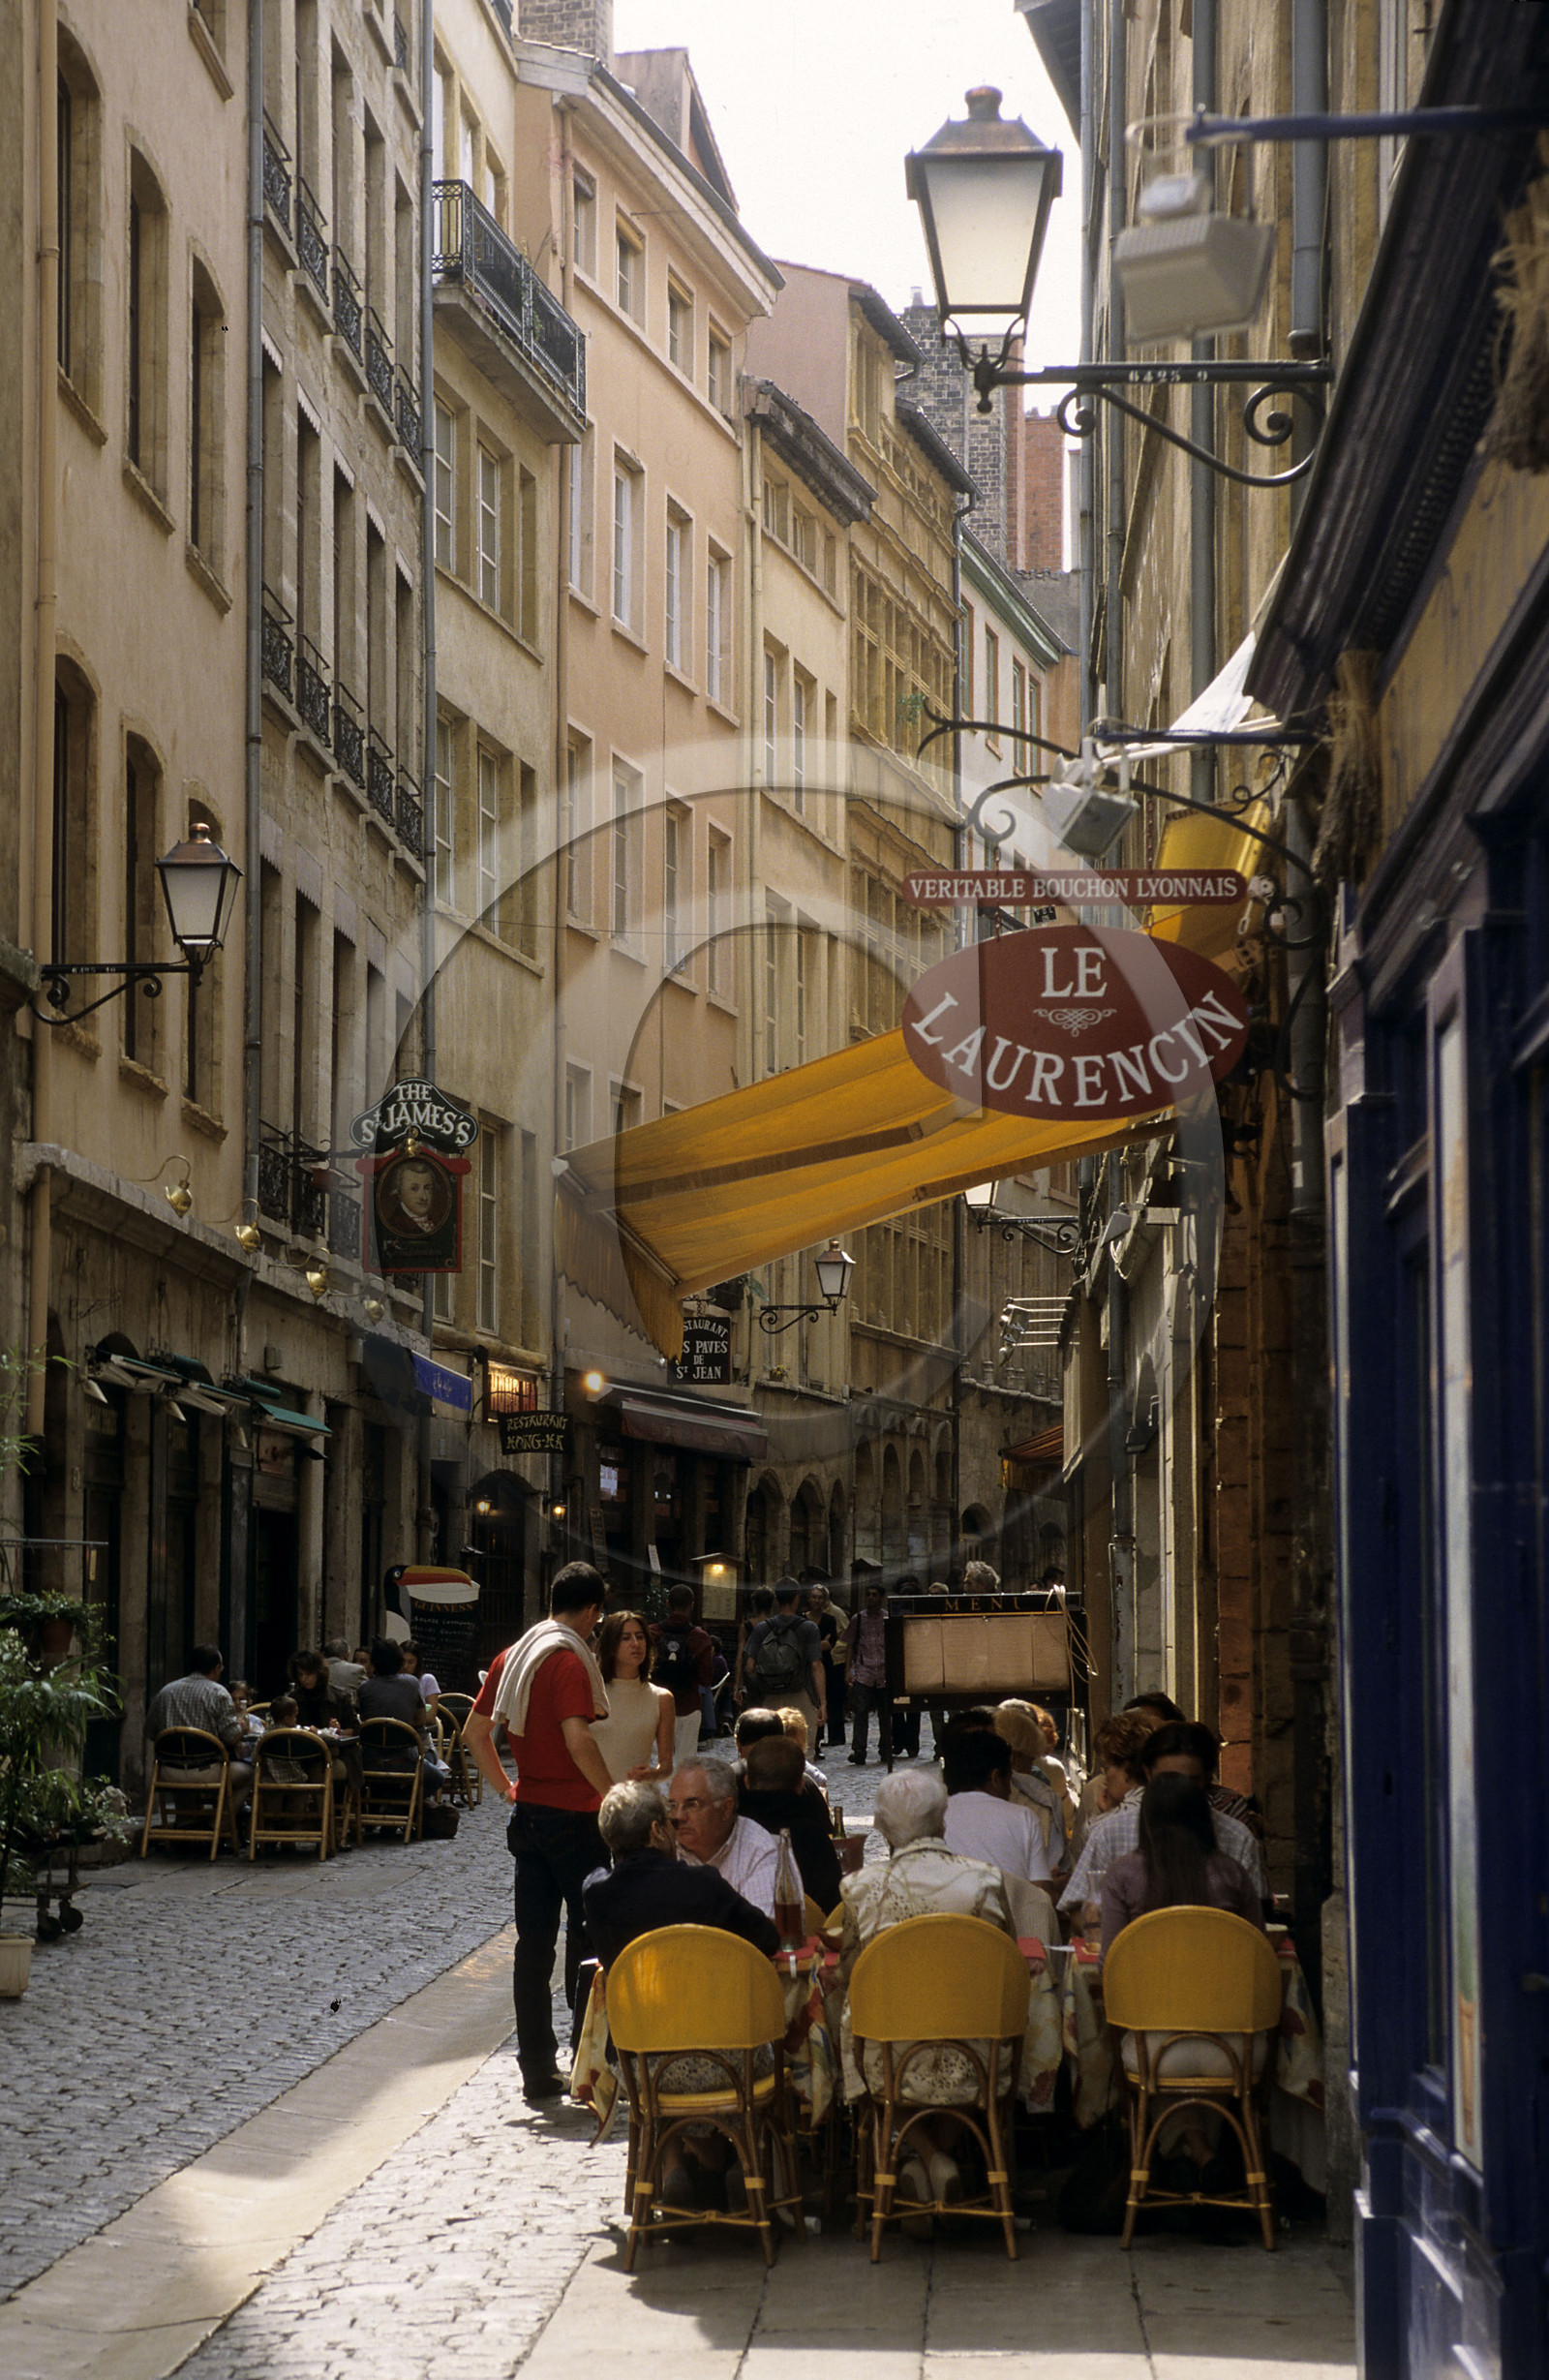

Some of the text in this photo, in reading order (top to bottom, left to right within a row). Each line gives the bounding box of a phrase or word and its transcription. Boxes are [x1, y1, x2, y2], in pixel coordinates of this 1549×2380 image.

[910, 877, 1238, 899] VERITABLE BOUCHON LYONNAIS
[1040, 947, 1108, 998] LE
[911, 990, 1245, 1108] LAURENCIN
[396, 1083, 433, 1102] THE
[683, 1319, 728, 1338] STAURANT
[695, 1340, 728, 1354] PAVES
[693, 1355, 704, 1365] DE
[692, 1366, 722, 1379] JEAN
[506, 1414, 569, 1432] RESTAURANT
[413, 1600, 473, 1613] GUINNESS
